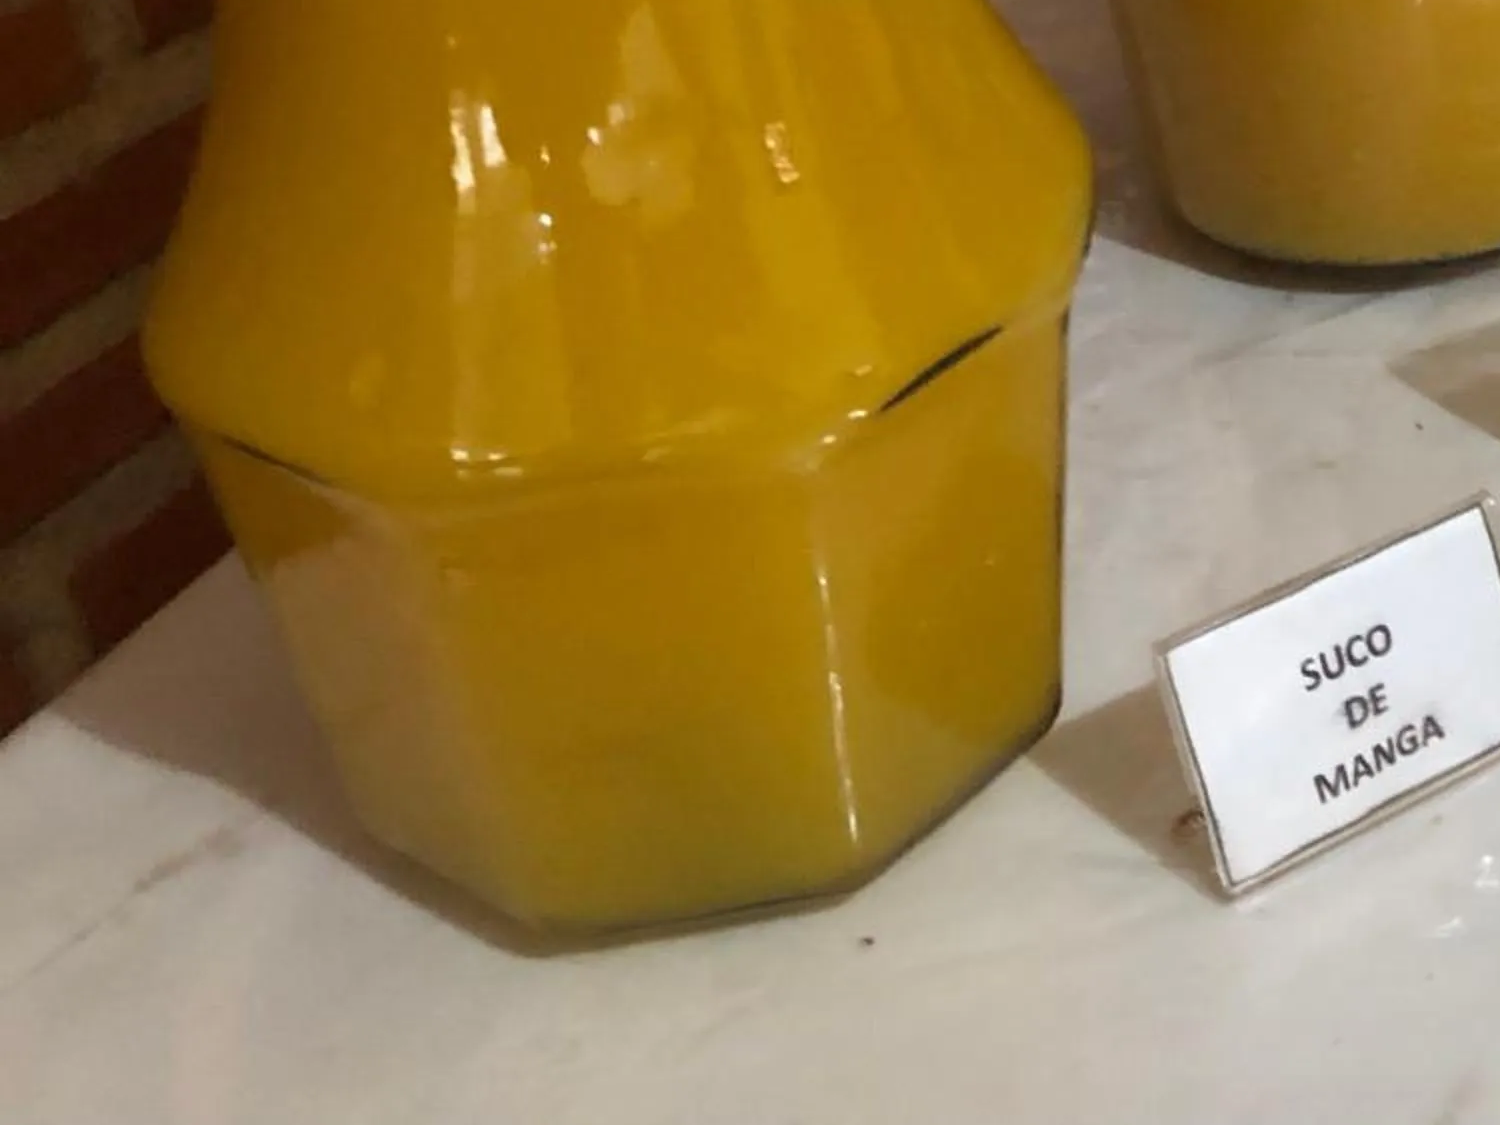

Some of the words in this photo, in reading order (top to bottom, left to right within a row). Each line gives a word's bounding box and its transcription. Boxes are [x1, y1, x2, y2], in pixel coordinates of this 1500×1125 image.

[1300, 623, 1393, 691] SUCO
[1342, 683, 1389, 730] DE
[1313, 714, 1446, 803] MANGA
